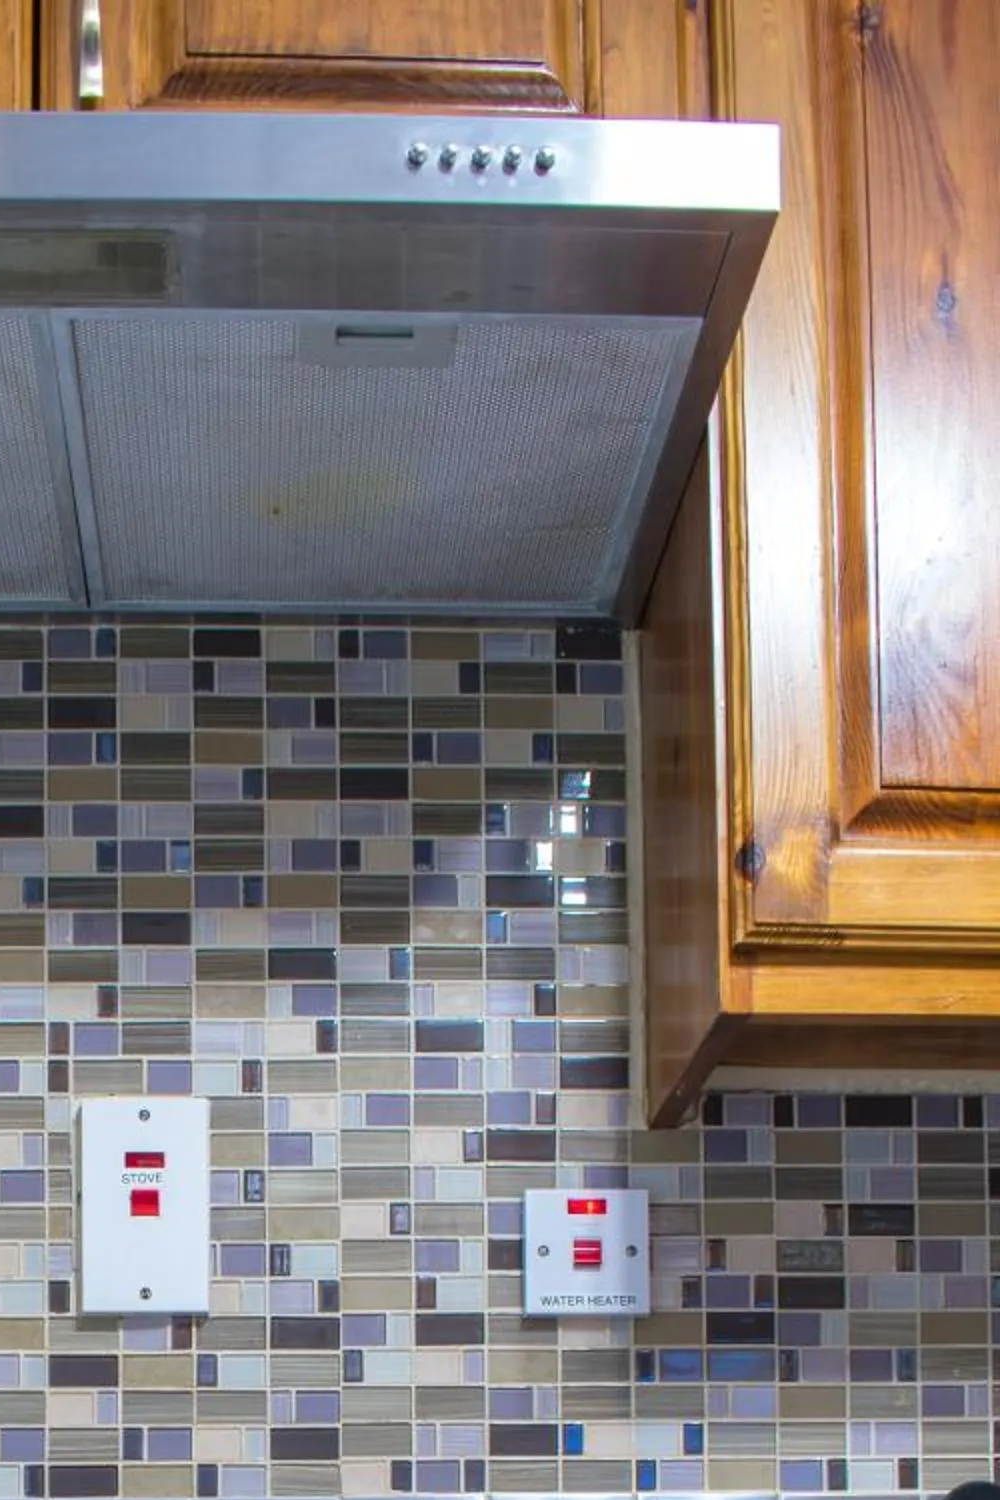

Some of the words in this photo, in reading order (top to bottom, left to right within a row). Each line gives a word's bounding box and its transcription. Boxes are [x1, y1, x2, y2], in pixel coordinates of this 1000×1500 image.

[121, 1172, 164, 1184] STOVE
[541, 1295, 584, 1307] WATER
[587, 1295, 637, 1306] HEATER
